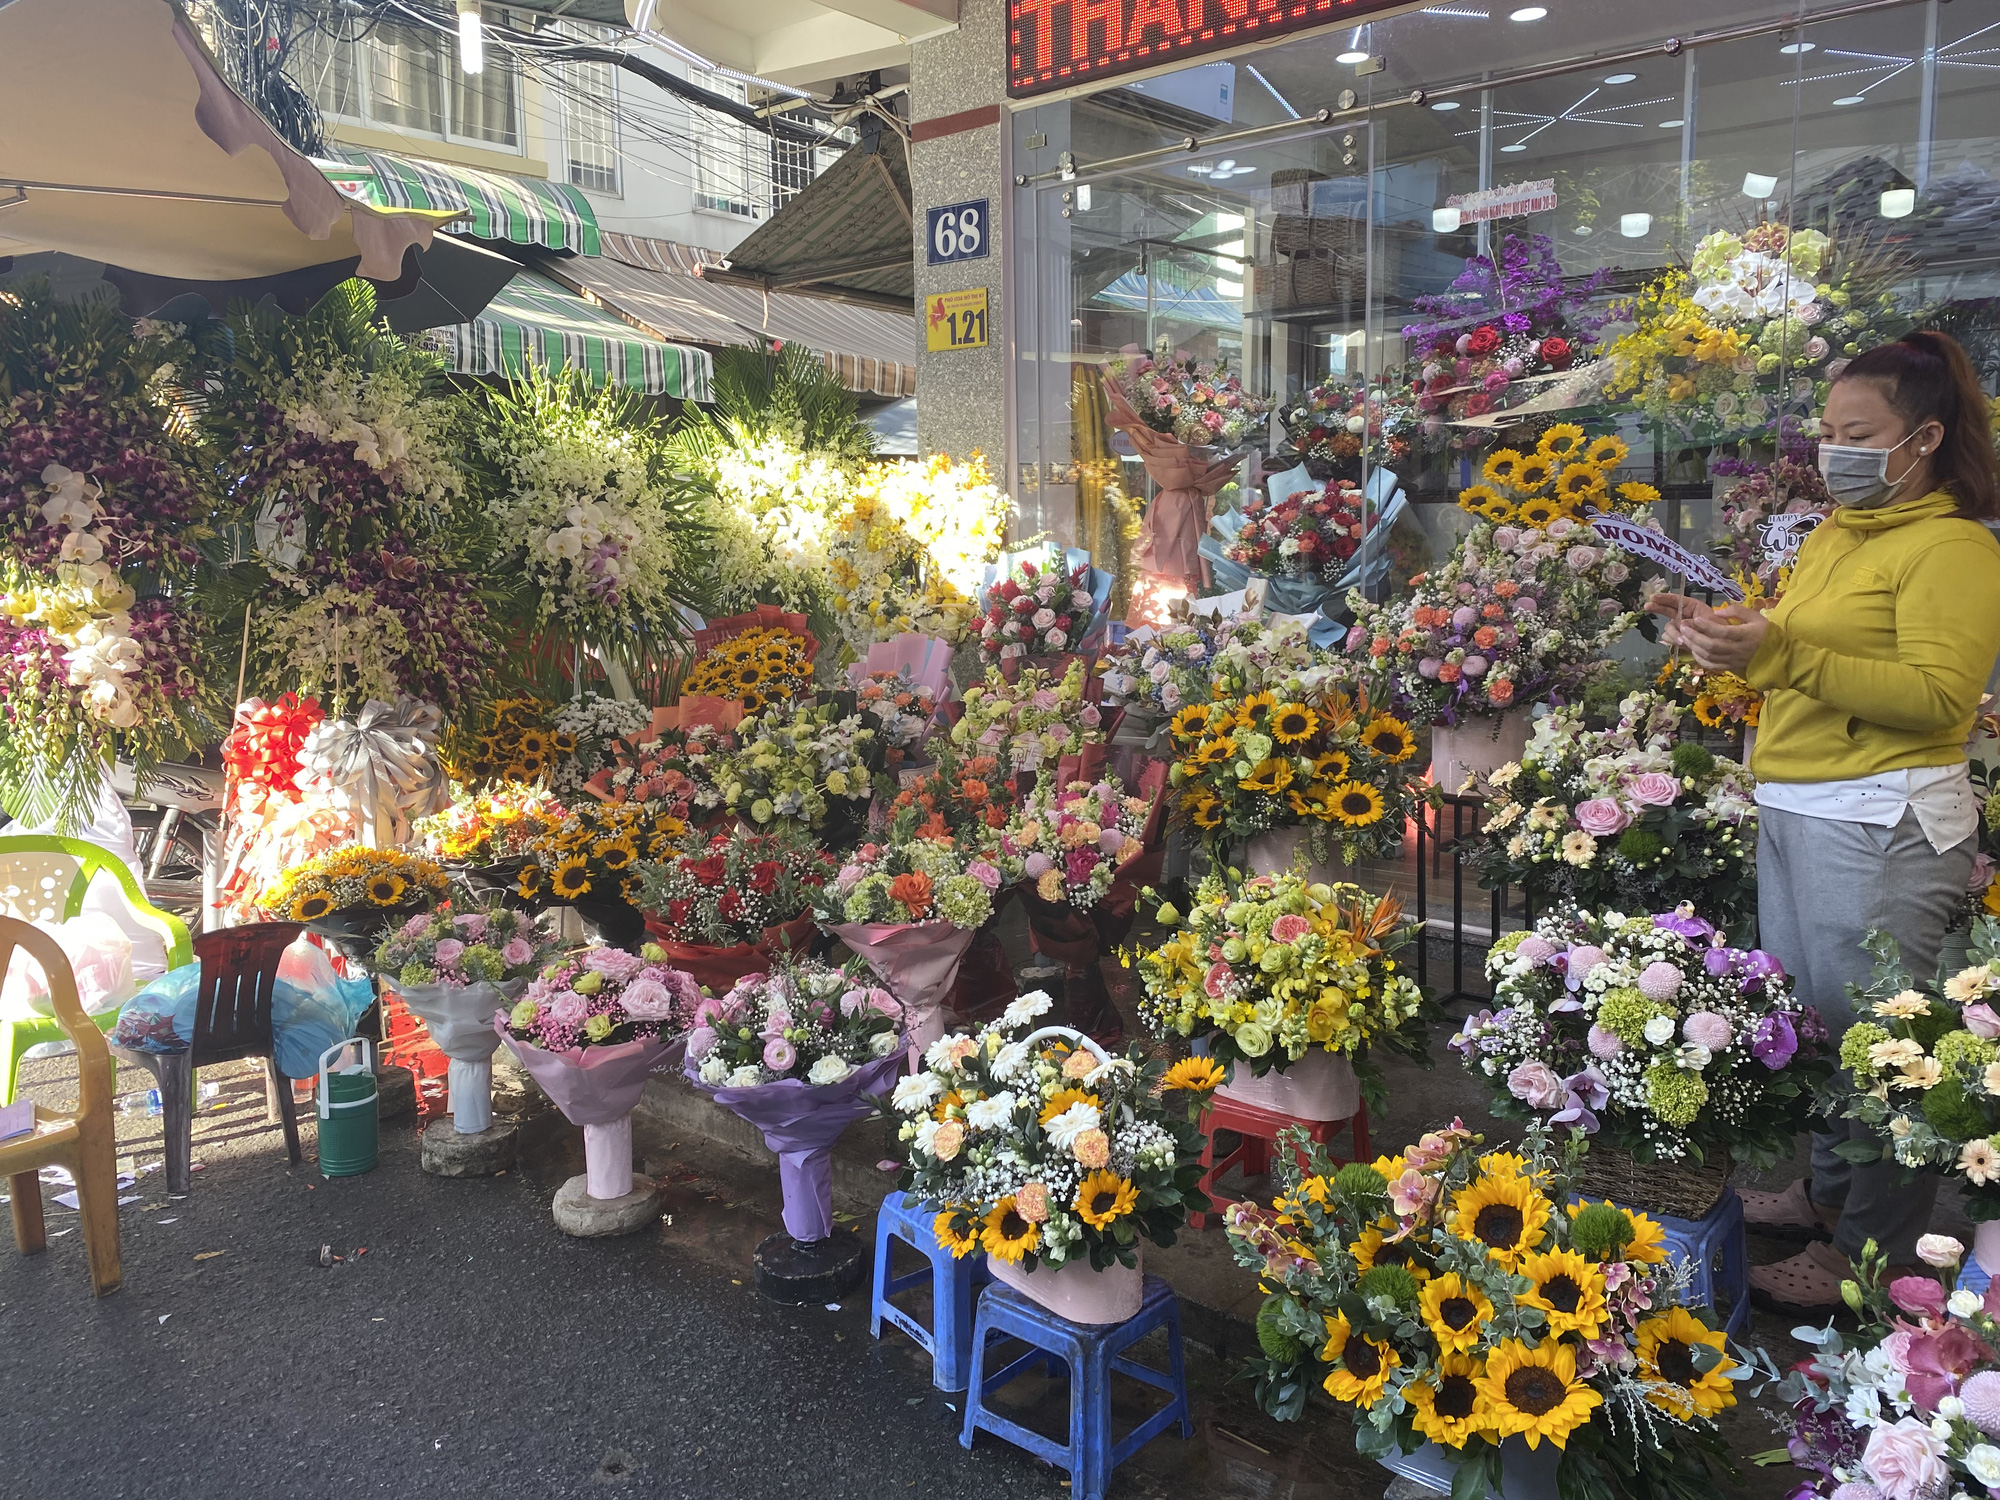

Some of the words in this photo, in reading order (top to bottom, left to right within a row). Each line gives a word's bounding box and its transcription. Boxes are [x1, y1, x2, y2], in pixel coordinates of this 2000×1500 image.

[1536, 179, 1553, 190] LONG
[935, 208, 980, 257] 68
[946, 308, 985, 346] 1.21
[1768, 514, 1800, 523] HAPPY
[1653, 553, 1681, 573] Day
